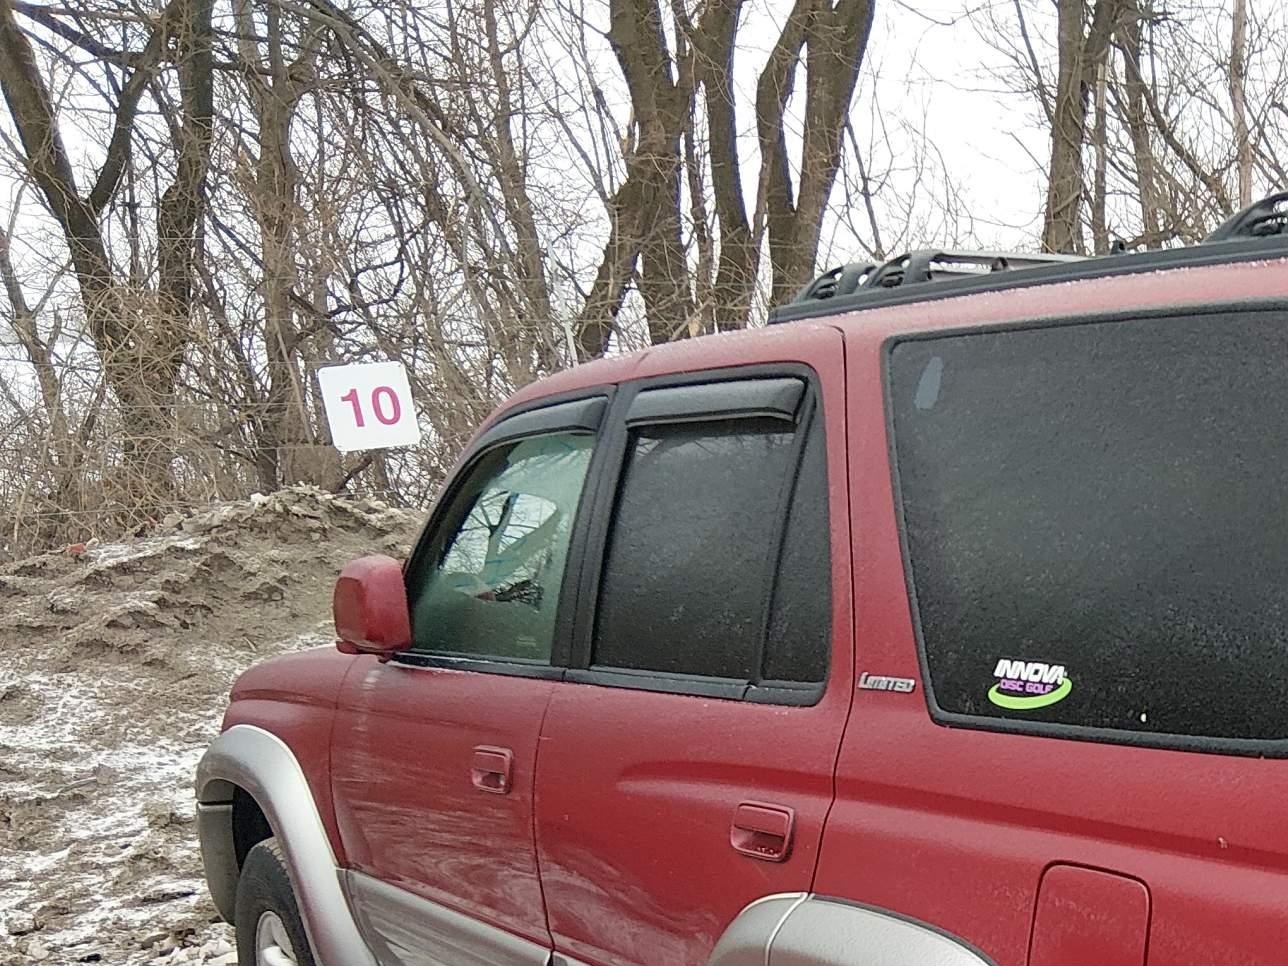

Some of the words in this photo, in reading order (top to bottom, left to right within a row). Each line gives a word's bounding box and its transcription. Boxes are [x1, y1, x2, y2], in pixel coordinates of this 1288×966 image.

[341, 386, 401, 427] 10
[993, 659, 1064, 685] INNOVA
[1000, 679, 1024, 692] DISC
[1025, 681, 1053, 694] GOLF
